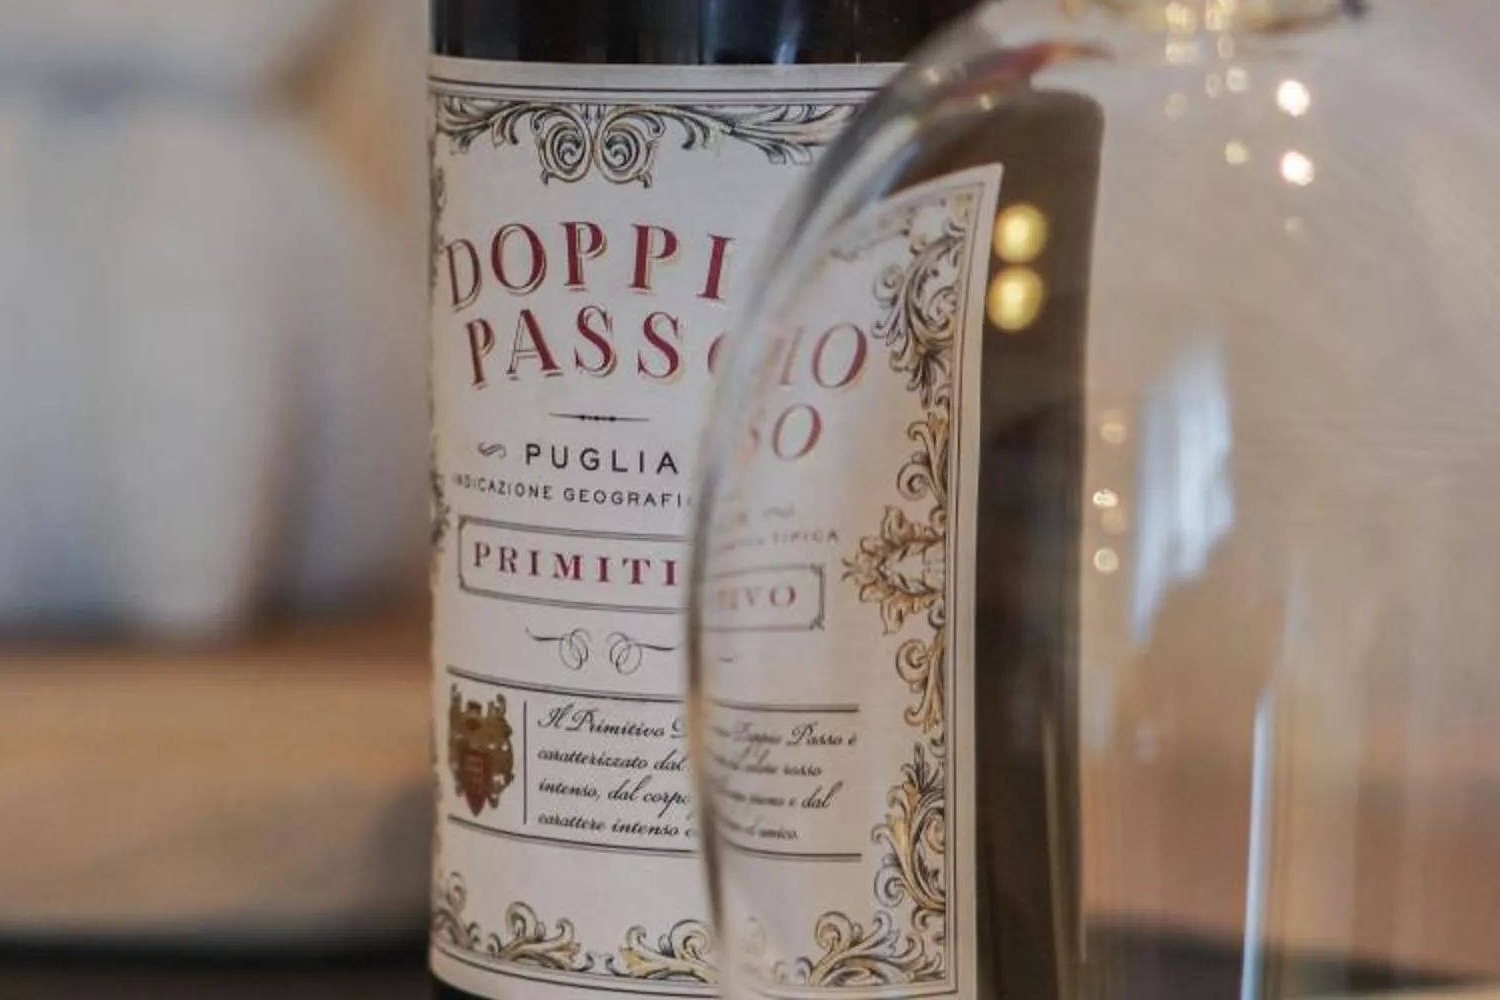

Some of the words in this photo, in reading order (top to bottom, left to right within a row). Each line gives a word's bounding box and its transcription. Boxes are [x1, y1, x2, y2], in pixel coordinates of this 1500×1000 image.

[446, 221, 736, 312] DOPPI
[525, 442, 679, 475] PUGLIA
[563, 487, 691, 509] GEOGRAFI
[474, 541, 678, 587] PRIMITI
[565, 706, 665, 738] Primitivo
[607, 774, 653, 802] dal
